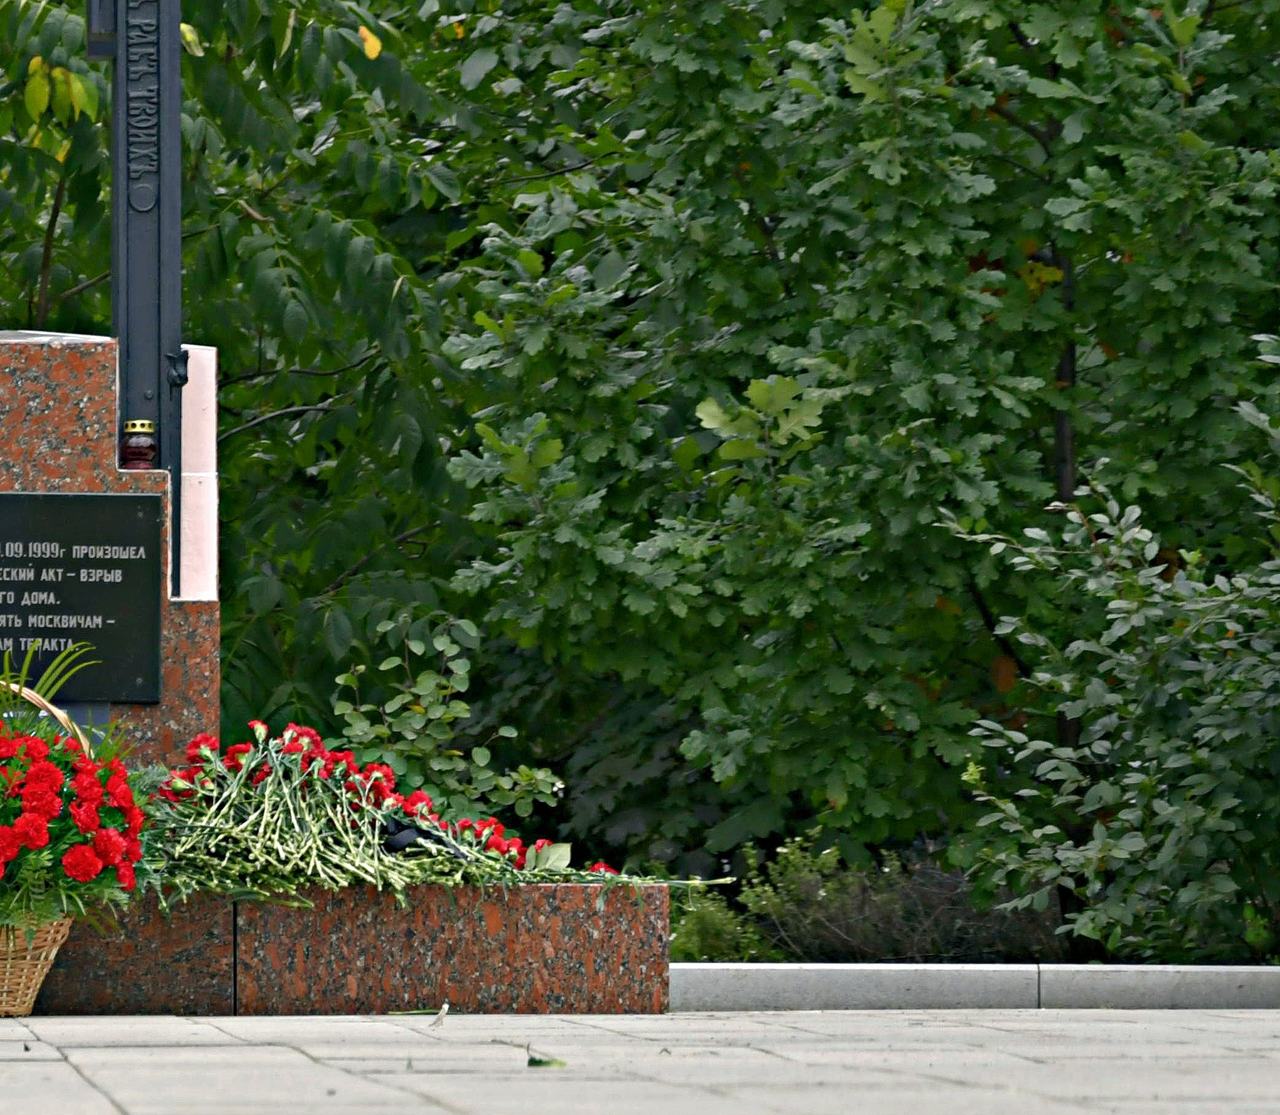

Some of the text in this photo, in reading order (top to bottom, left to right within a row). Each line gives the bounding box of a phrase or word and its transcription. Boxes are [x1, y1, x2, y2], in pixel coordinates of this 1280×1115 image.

[72, 545, 146, 559] ПРОИЗОШЕЛ
[40, 568, 64, 582] АКТ
[79, 568, 123, 583] ВЗРЫВ
[20, 591, 61, 606] ДОМА.
[28, 614, 103, 629] МОСКВИЧАМ
